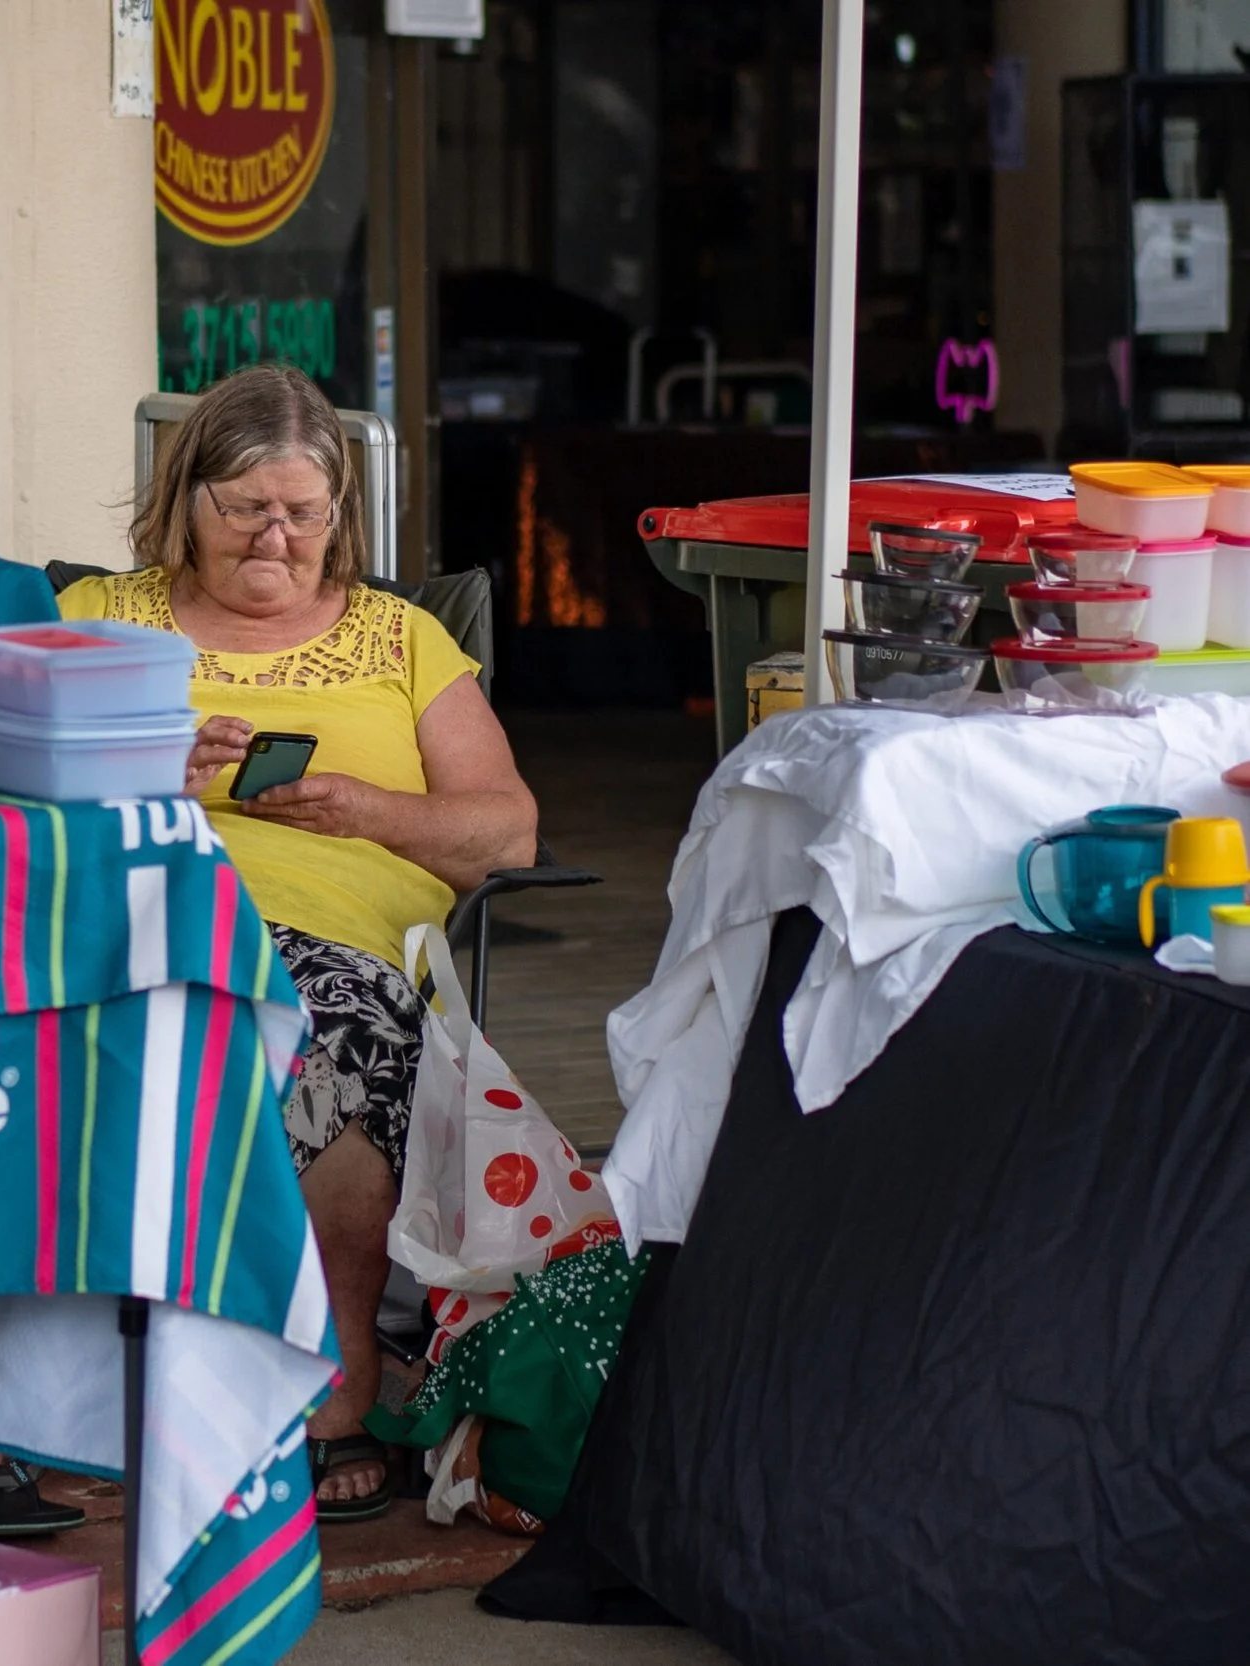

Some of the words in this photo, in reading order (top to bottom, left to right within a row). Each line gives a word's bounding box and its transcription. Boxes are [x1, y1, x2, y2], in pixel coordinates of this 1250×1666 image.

[154, 0, 308, 115] NOBLE
[156, 121, 228, 203] CHINESE
[231, 123, 302, 203] KITCHEN
